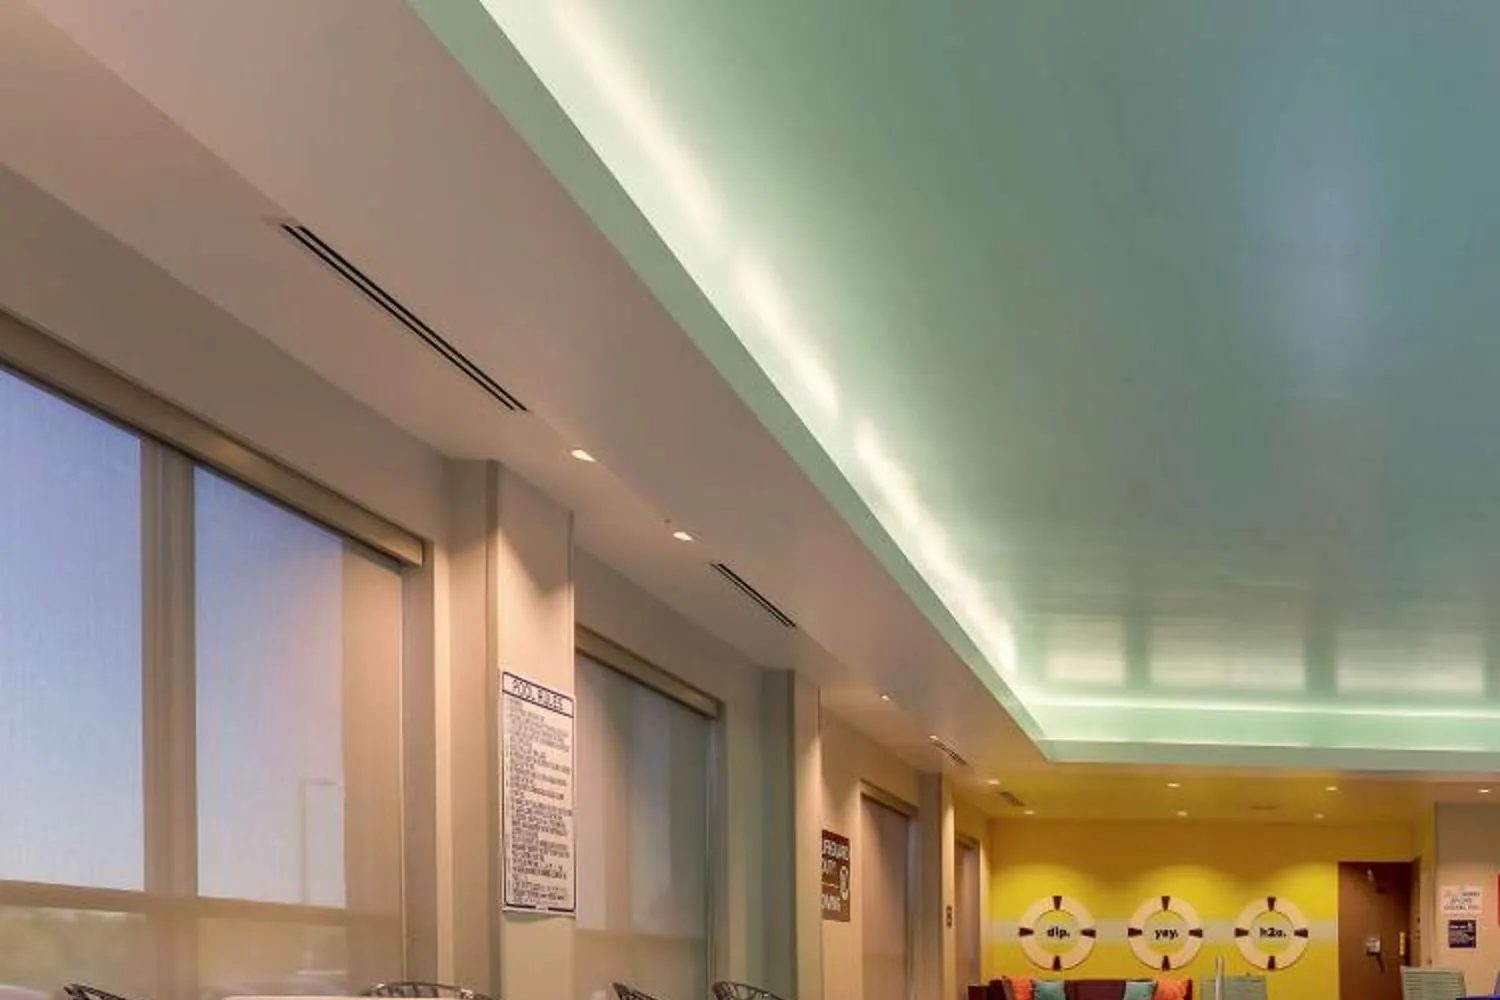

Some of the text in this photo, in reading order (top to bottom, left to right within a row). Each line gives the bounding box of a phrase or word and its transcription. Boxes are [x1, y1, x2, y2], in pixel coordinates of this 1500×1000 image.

[1047, 925, 1071, 939] dip.
[1154, 928, 1179, 940] yay.
[1259, 926, 1287, 938] h2o.
